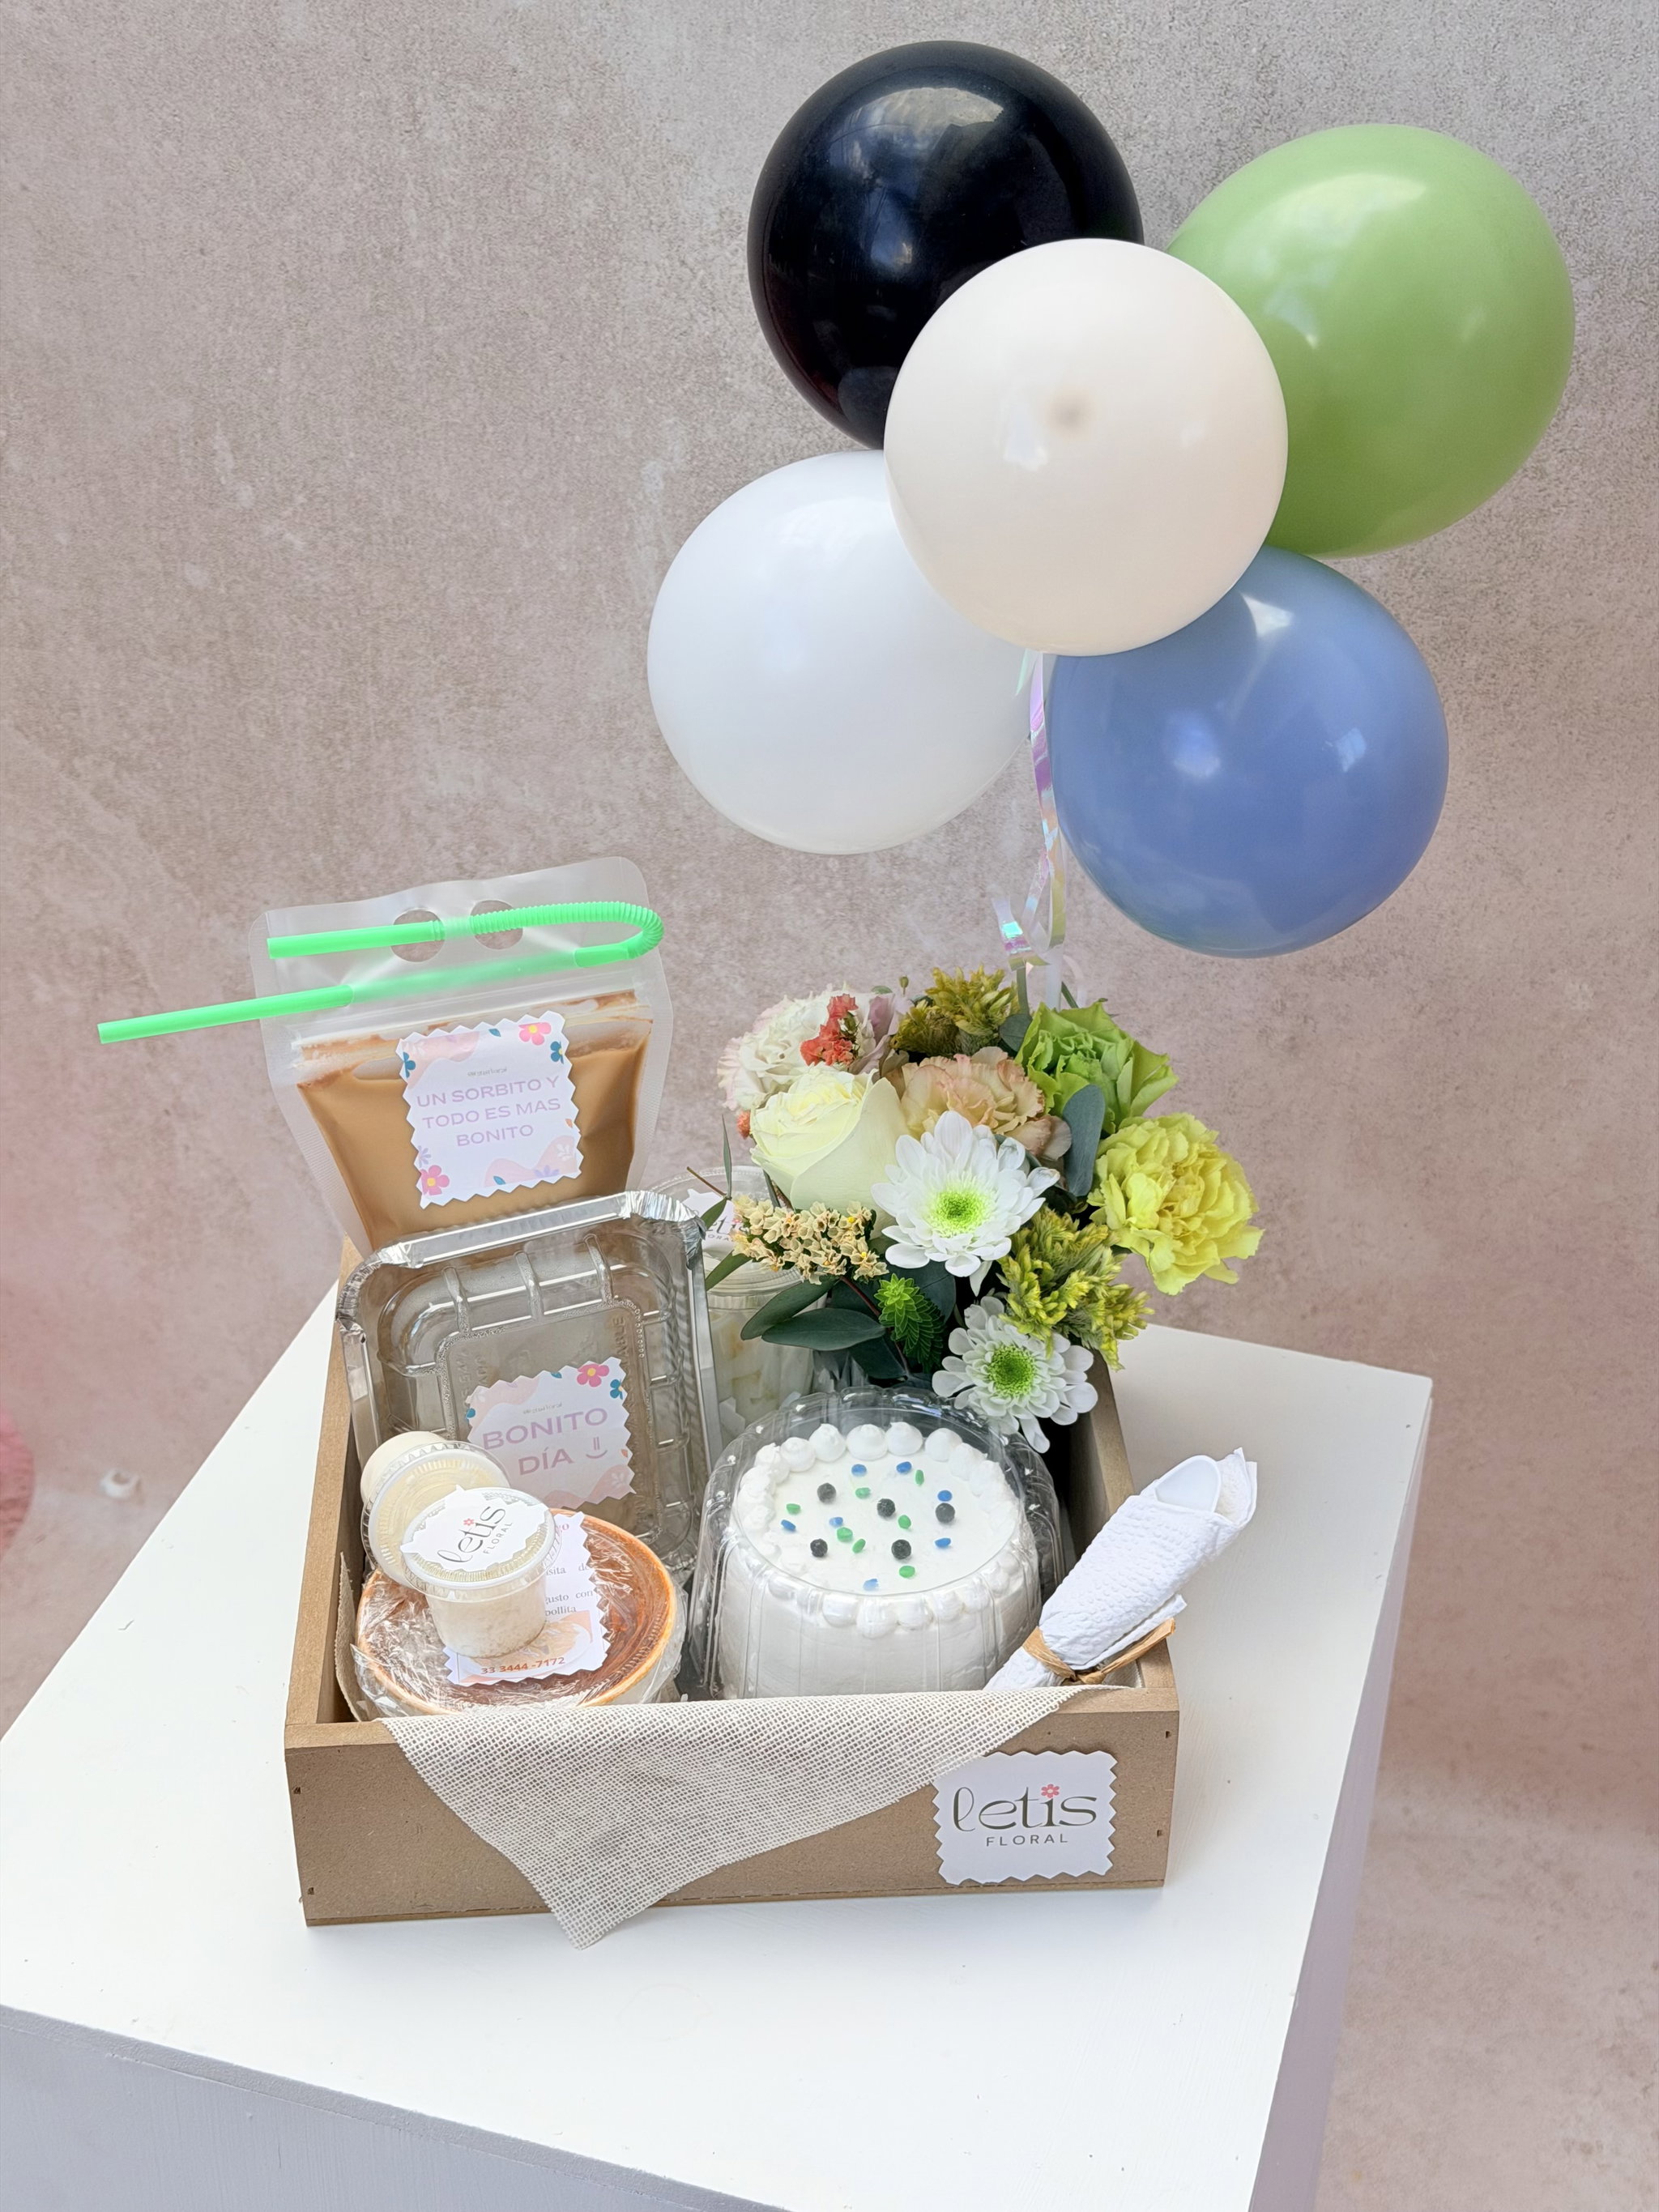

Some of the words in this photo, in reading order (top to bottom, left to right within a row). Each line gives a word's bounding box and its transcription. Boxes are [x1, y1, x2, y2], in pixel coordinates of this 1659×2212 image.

[416, 1092, 446, 1107] UN
[452, 1079, 542, 1103] SORBITO
[546, 1076, 560, 1089] Y
[422, 1110, 480, 1129] TODO
[486, 1106, 511, 1120] ES
[515, 1098, 561, 1115] MAS
[456, 1124, 534, 1147] BONITO
[482, 1408, 608, 1451] BONITO
[518, 1447, 575, 1476] DÍA
[437, 1506, 506, 1563] letis
[483, 1522, 513, 1554] FLORAL
[499, 1663, 528, 1673] 3444
[953, 1784, 1098, 1832] letis
[986, 1833, 1068, 1848] FLORAL
